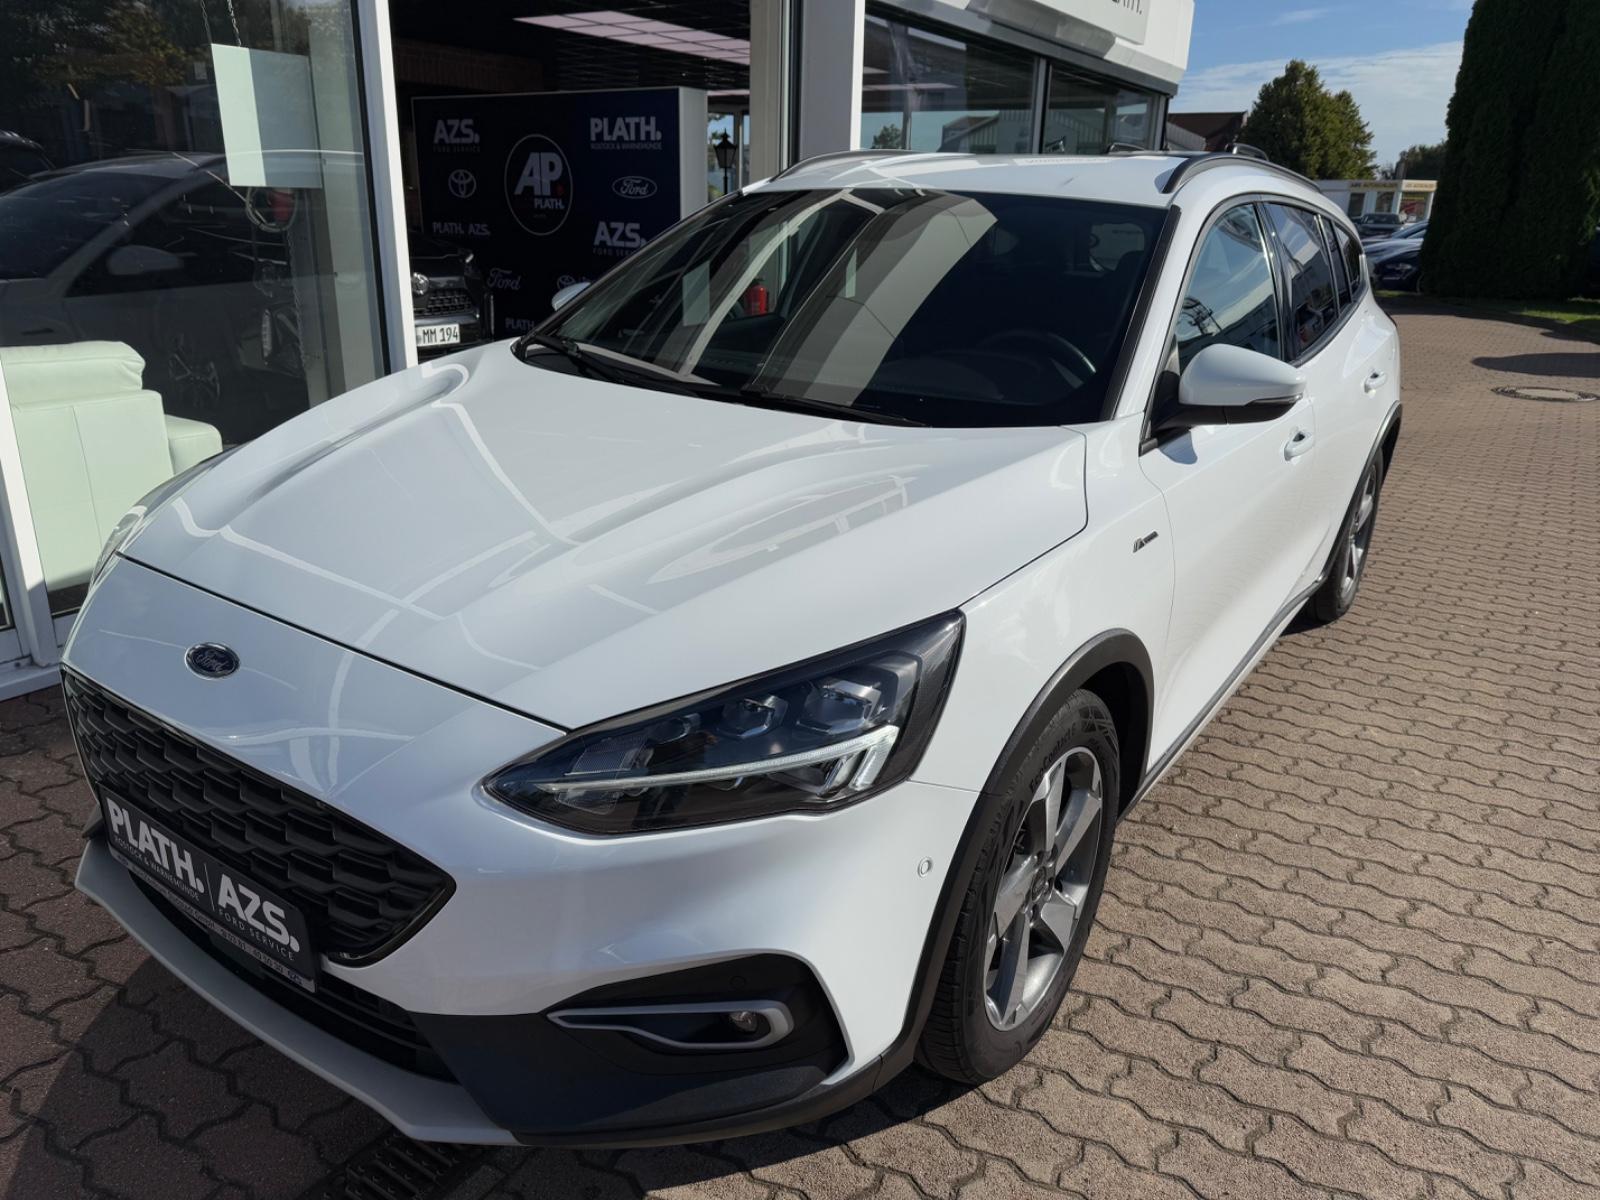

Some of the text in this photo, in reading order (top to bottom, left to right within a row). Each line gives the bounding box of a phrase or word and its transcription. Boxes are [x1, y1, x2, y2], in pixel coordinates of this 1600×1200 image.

[434, 119, 480, 144] AZS.
[590, 117, 662, 141] PLATH.
[620, 178, 649, 195] Ford
[533, 197, 565, 209] PLATH.
[432, 221, 491, 236] PLATH. AZS.
[593, 220, 647, 248] AZS.
[486, 267, 521, 290] Ford
[423, 326, 458, 344] MM 194
[106, 797, 299, 952] PLATH. AZS.
[218, 907, 244, 931] FORD
[249, 927, 294, 961] SERVICE
